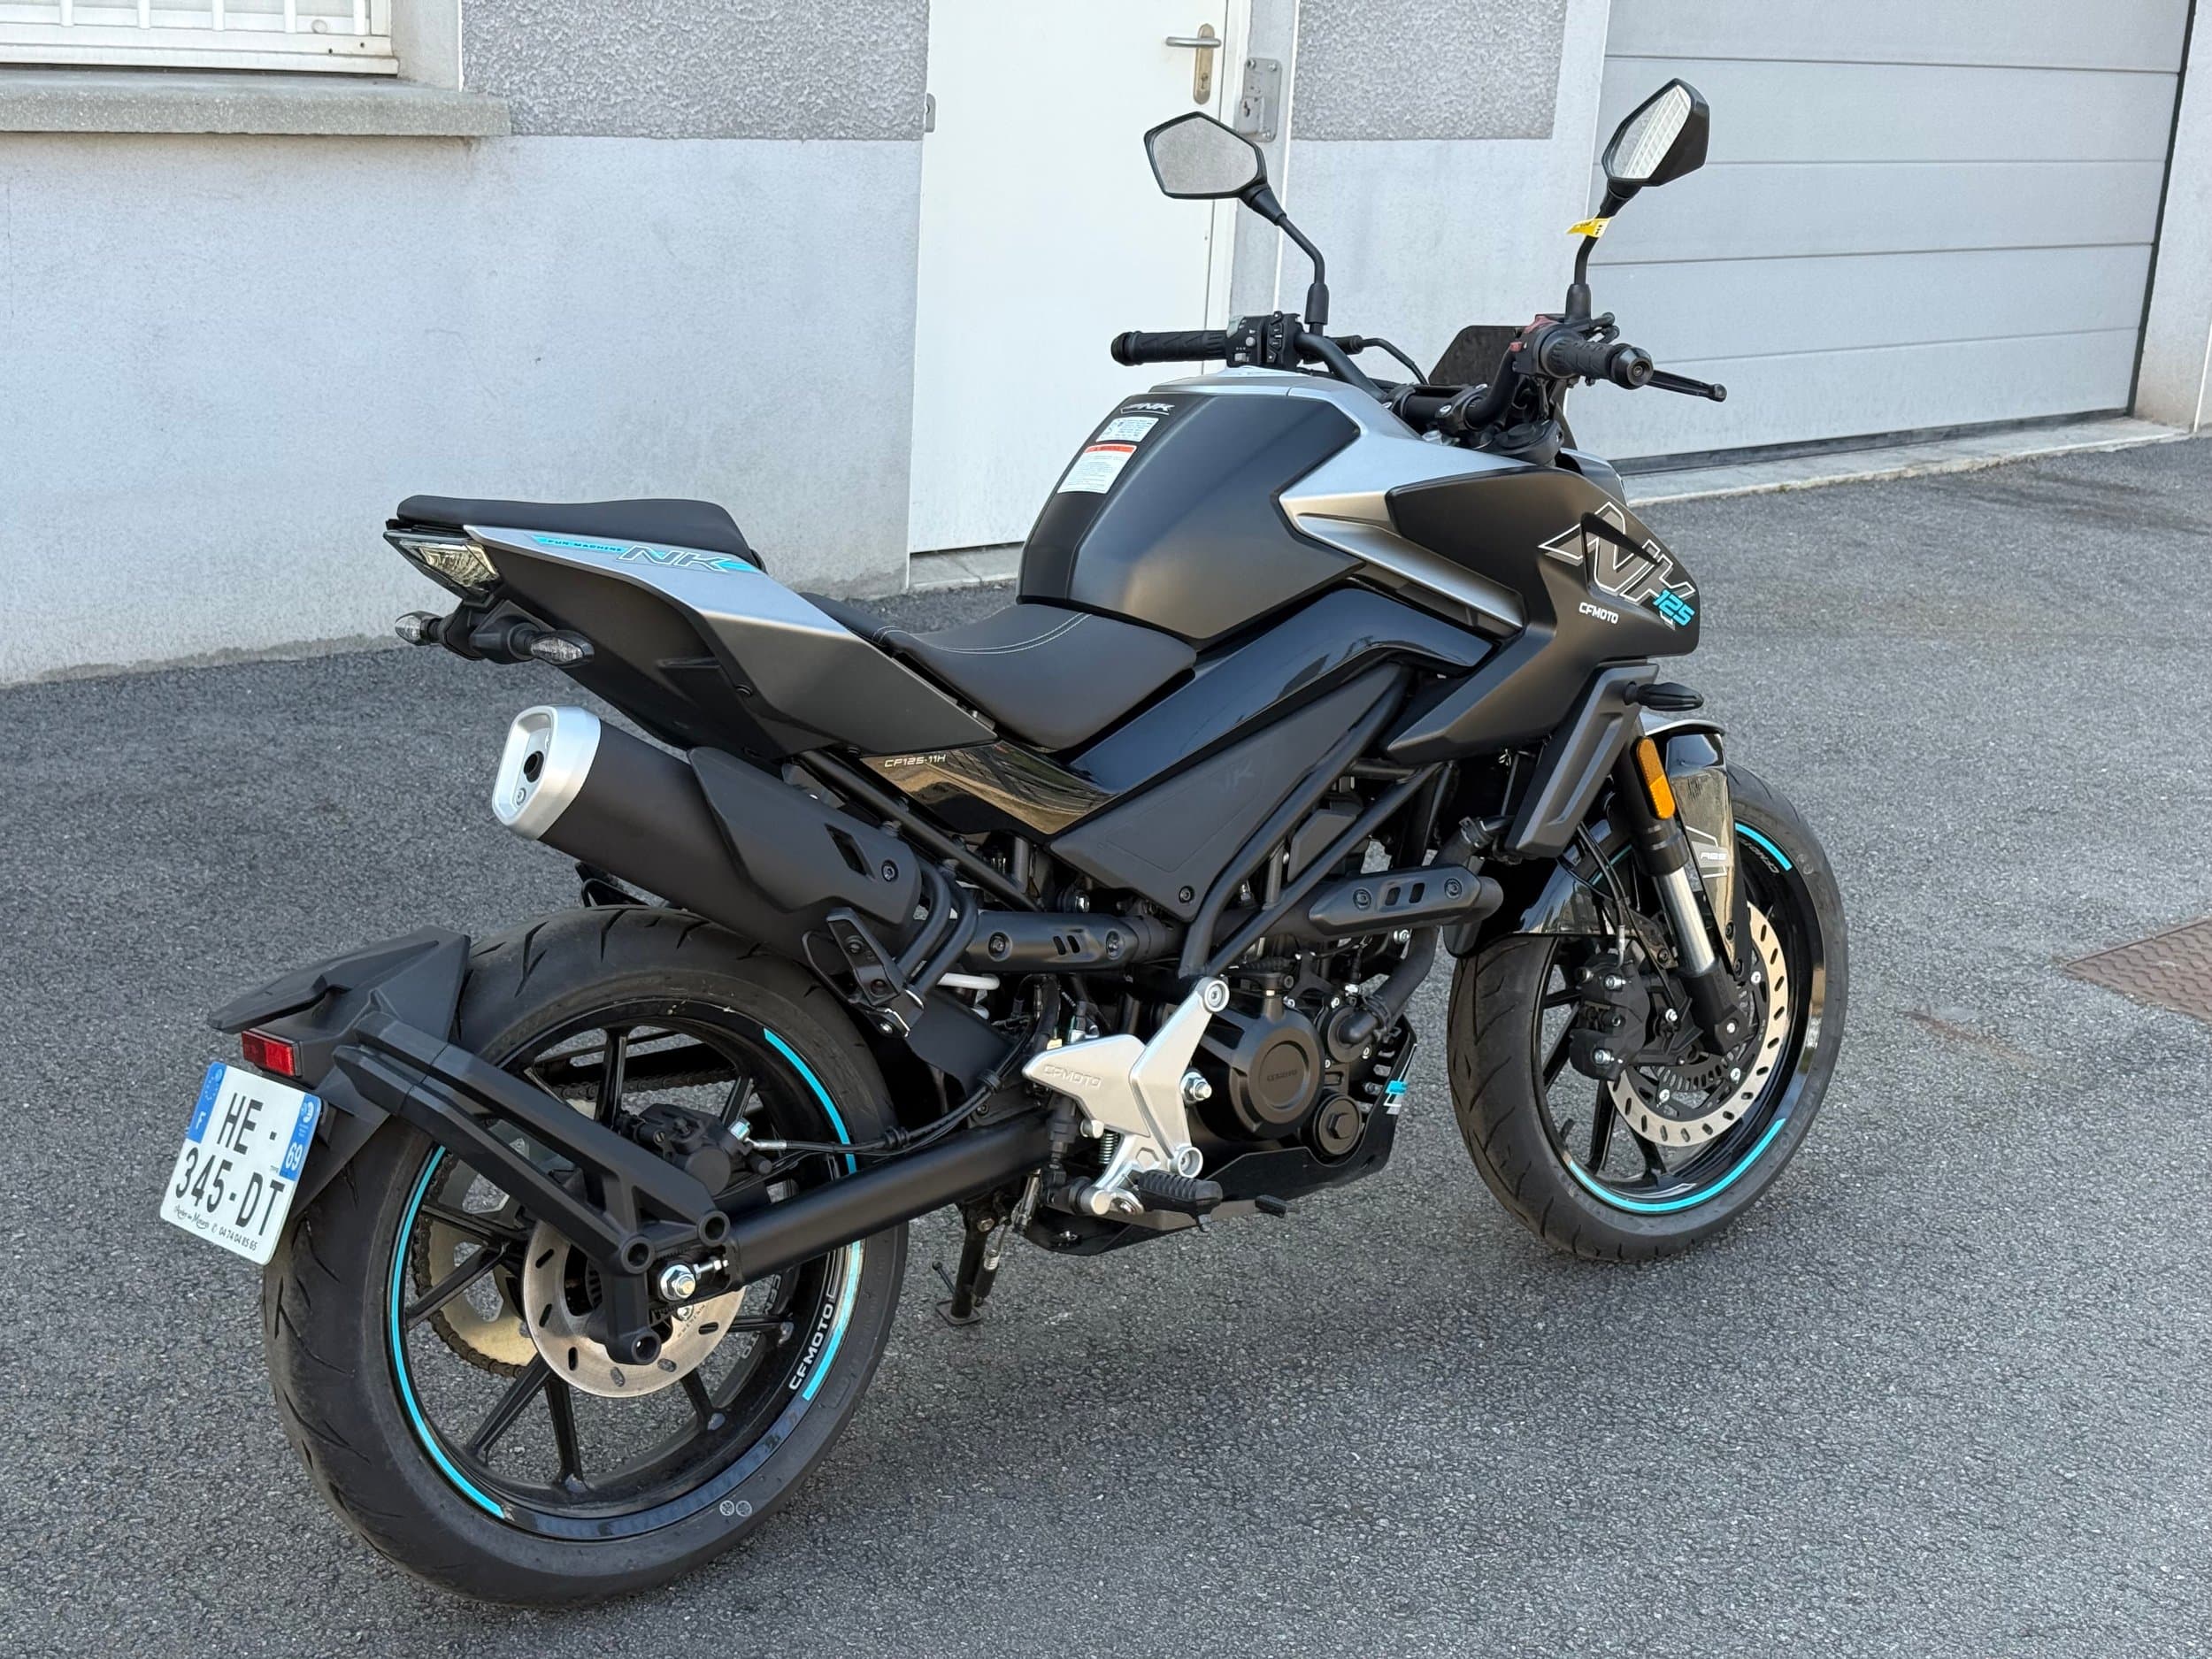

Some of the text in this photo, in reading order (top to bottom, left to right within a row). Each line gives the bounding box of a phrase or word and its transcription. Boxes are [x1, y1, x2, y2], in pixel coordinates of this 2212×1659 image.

[616, 544, 729, 573] NK
[1578, 602, 1619, 625] CFMOTO
[1652, 589, 1696, 626] 125
[1044, 1064, 1102, 1089] CFMOTO
[195, 1110, 207, 1131] F
[285, 1141, 303, 1171] 69
[175, 1147, 285, 1236] 345-DT
[788, 1303, 833, 1391] CFMOTO
